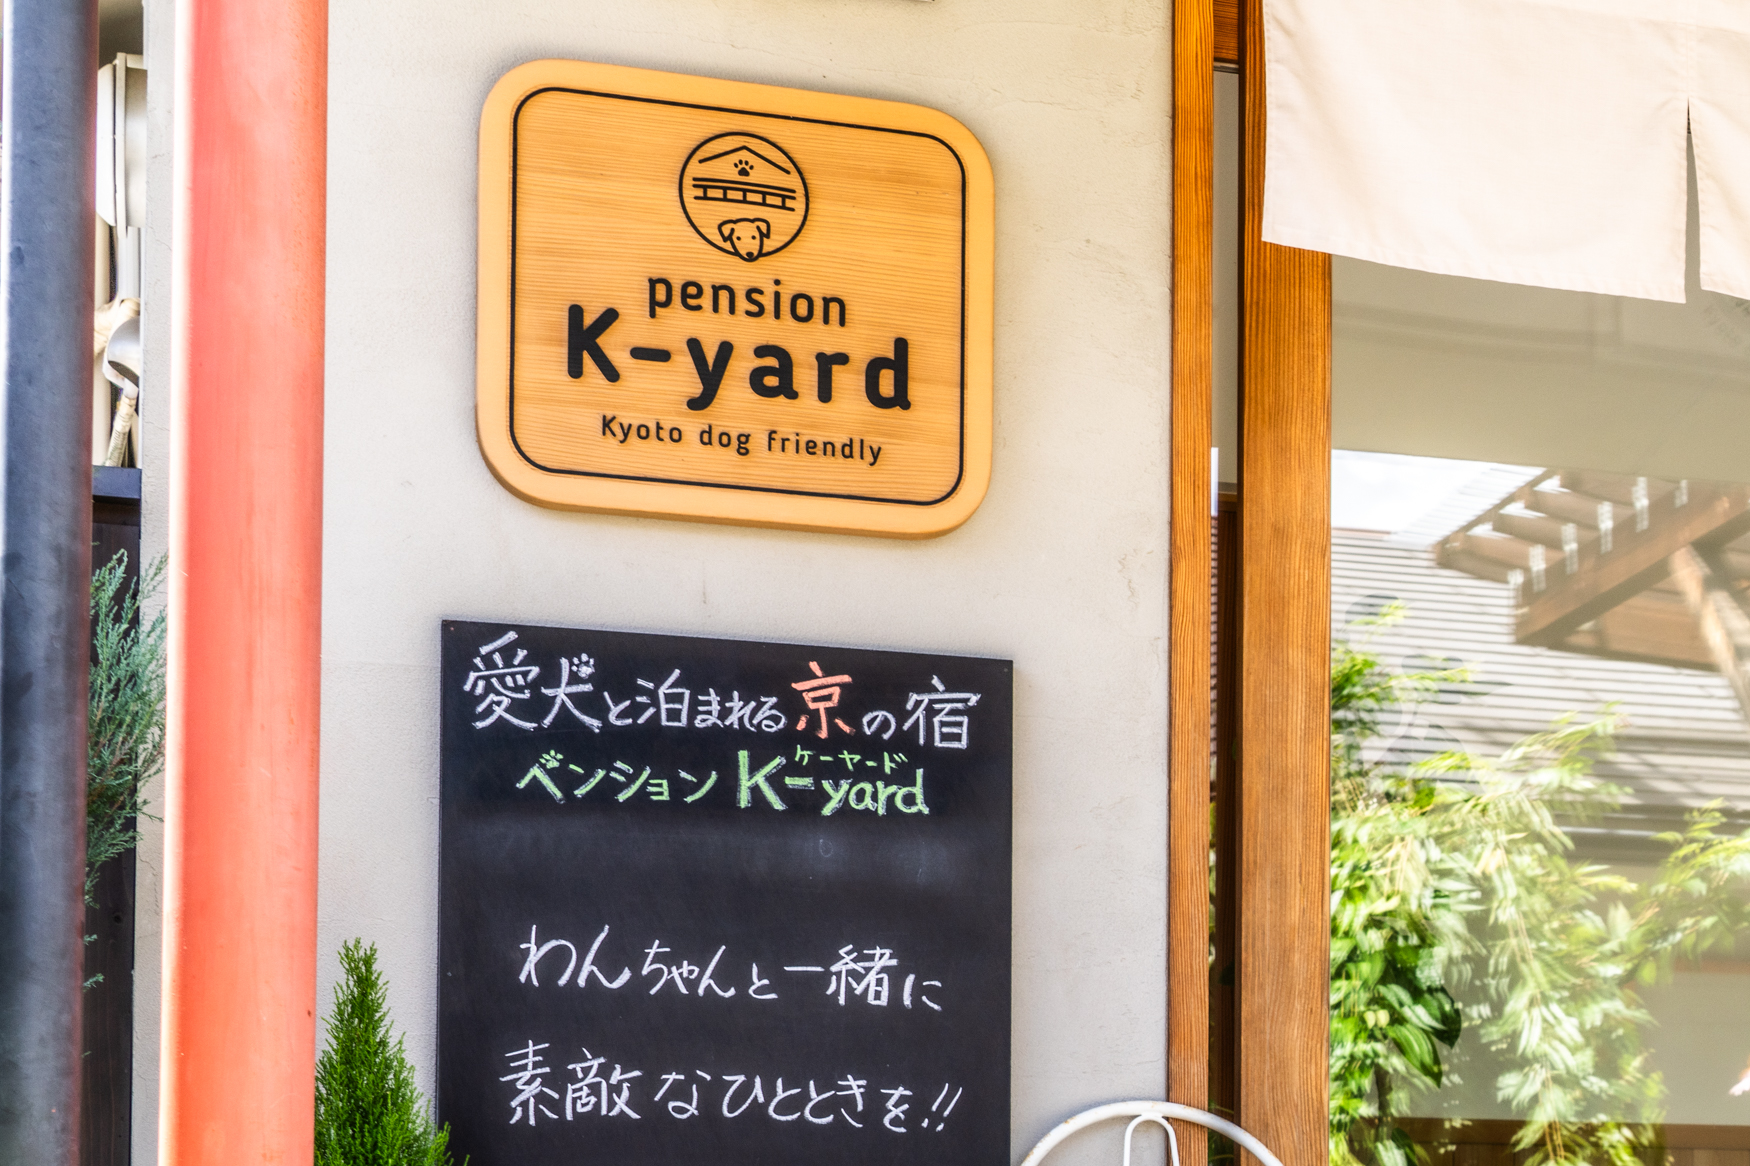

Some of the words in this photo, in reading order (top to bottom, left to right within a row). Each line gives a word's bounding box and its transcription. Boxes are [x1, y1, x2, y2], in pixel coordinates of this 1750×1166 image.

[648, 276, 846, 327] pension
[567, 304, 912, 411] K-yard
[601, 414, 683, 445] Kyoto
[699, 424, 752, 457] dog
[766, 431, 883, 467] friendly
[463, 630, 982, 750] 愛犬と泊まれる京の宿
[736, 749, 930, 816] K-yard
[795, 744, 909, 774] ケーヤード
[518, 924, 942, 1011] わんちゃんと一緒に
